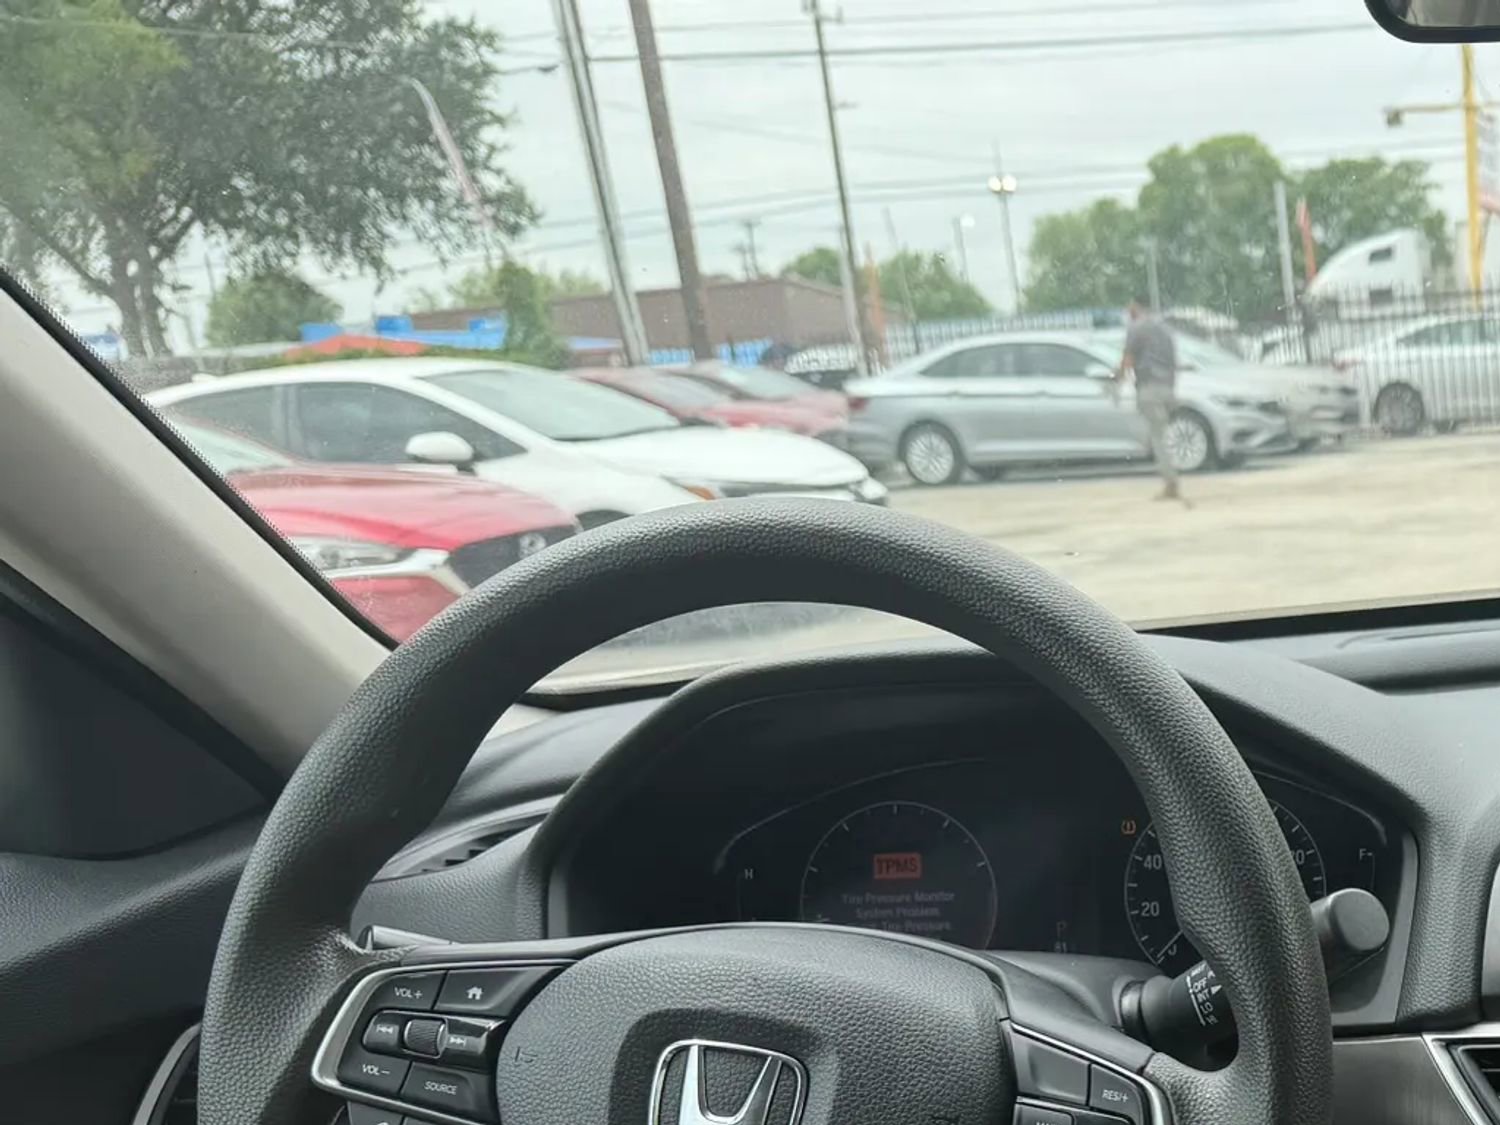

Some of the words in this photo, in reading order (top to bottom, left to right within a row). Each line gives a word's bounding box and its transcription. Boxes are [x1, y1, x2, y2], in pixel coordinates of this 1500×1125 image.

[877, 857, 918, 875] TPMS
[1143, 854, 1163, 870] 40
[1141, 902, 1160, 917] 20
[1193, 977, 1208, 992] OFF
[424, 1081, 458, 1095] SOURCE
